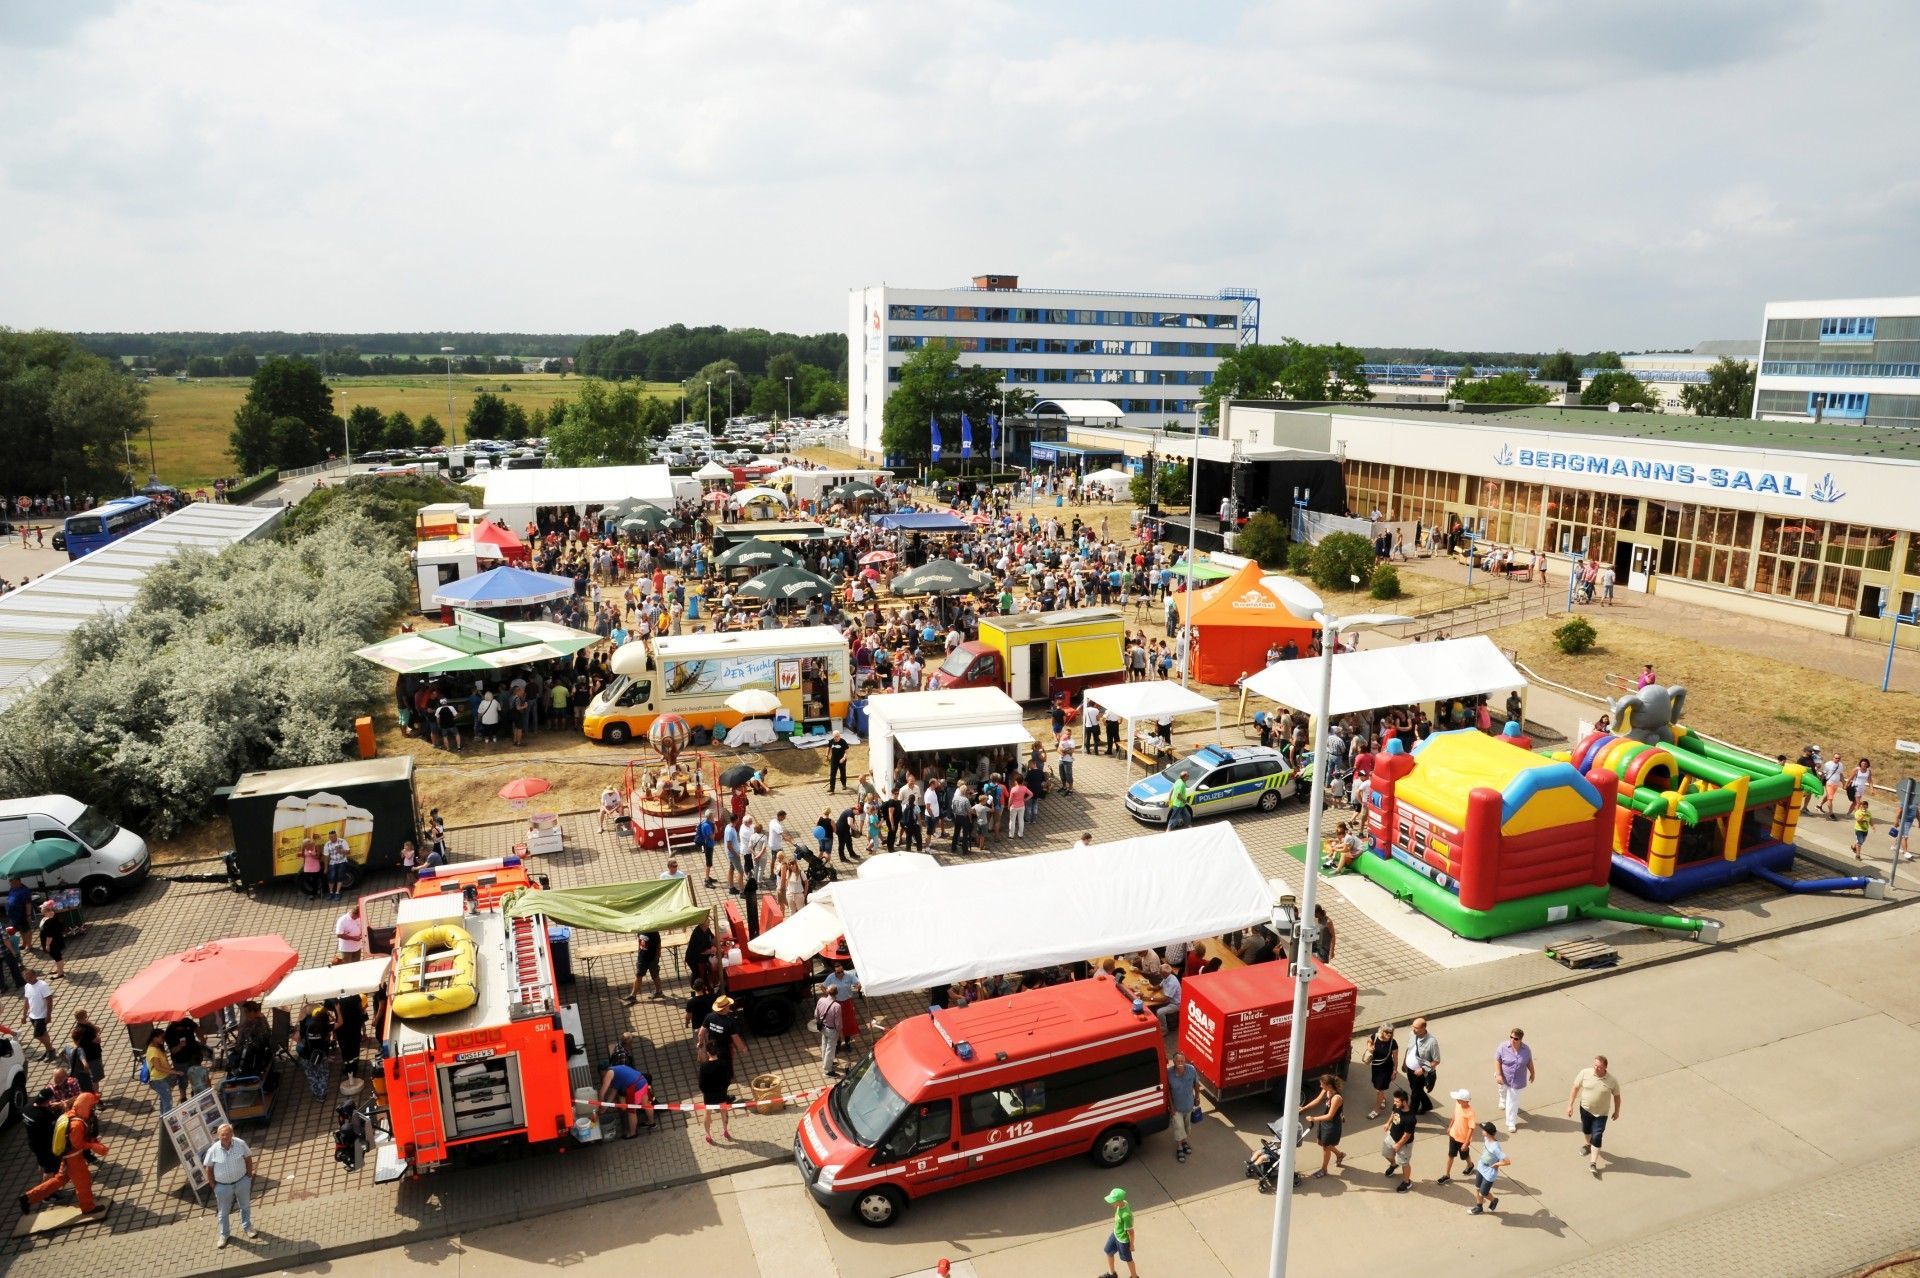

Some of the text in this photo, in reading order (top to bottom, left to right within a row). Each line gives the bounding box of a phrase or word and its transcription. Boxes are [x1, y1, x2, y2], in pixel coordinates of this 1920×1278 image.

[1519, 450, 1802, 496] BERGMANNS-SAAL
[723, 667, 745, 679] DER
[1198, 792, 1224, 802] POLIZEI
[1188, 999, 1208, 1030] ÖSA
[535, 1023, 550, 1032] 52/1
[1238, 1044, 1265, 1054] Wäscherei
[1006, 1121, 1034, 1139] 112
